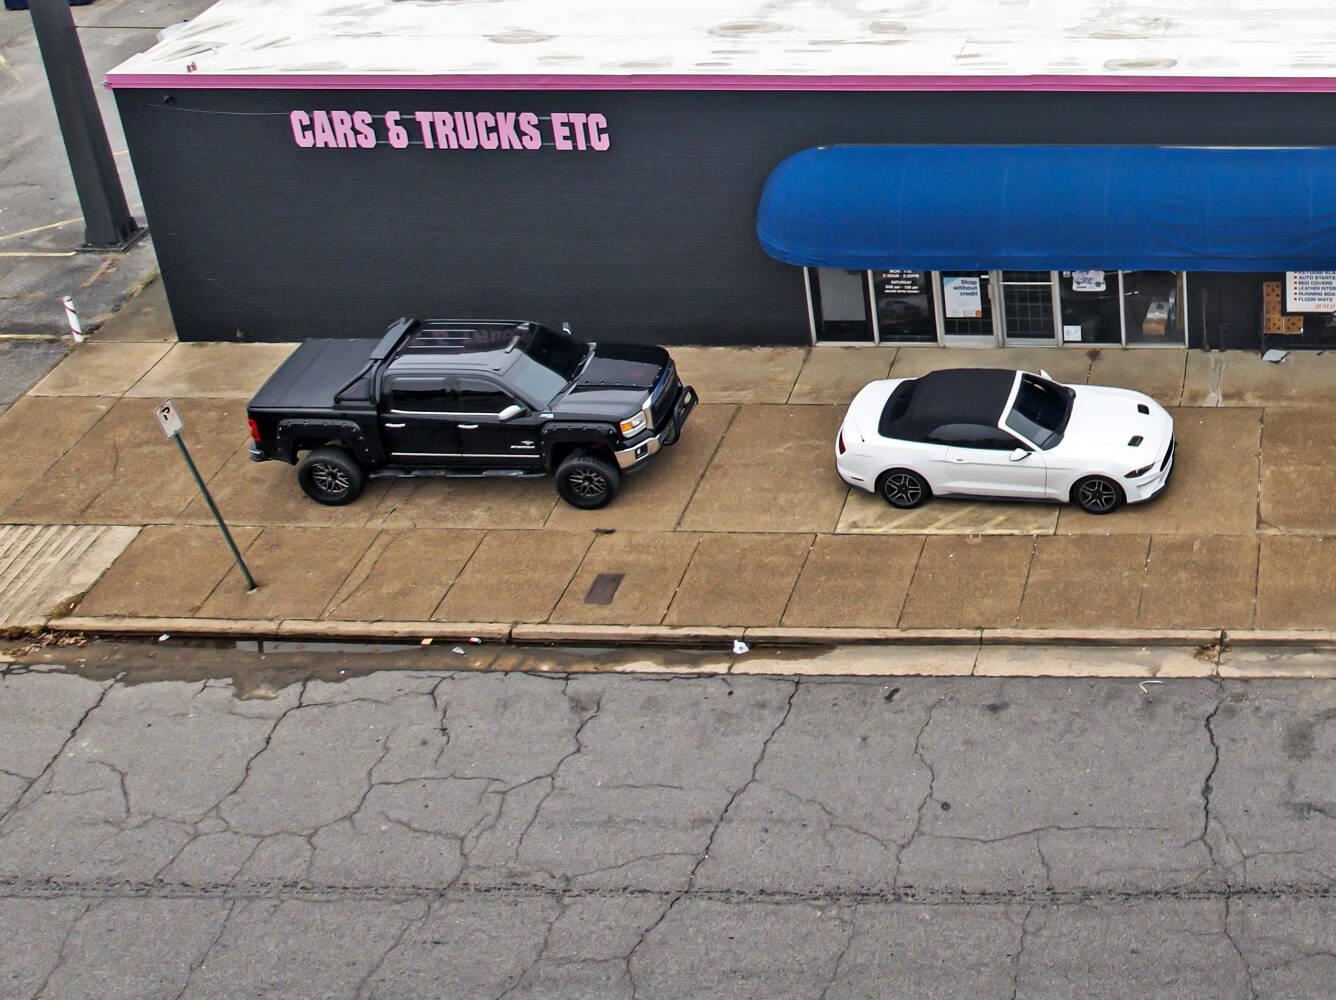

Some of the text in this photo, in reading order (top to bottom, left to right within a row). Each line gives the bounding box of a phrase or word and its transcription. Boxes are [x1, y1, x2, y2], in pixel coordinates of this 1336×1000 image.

[289, 110, 377, 149] CARS
[415, 111, 543, 151] TRUCKS
[550, 112, 611, 151] ETC
